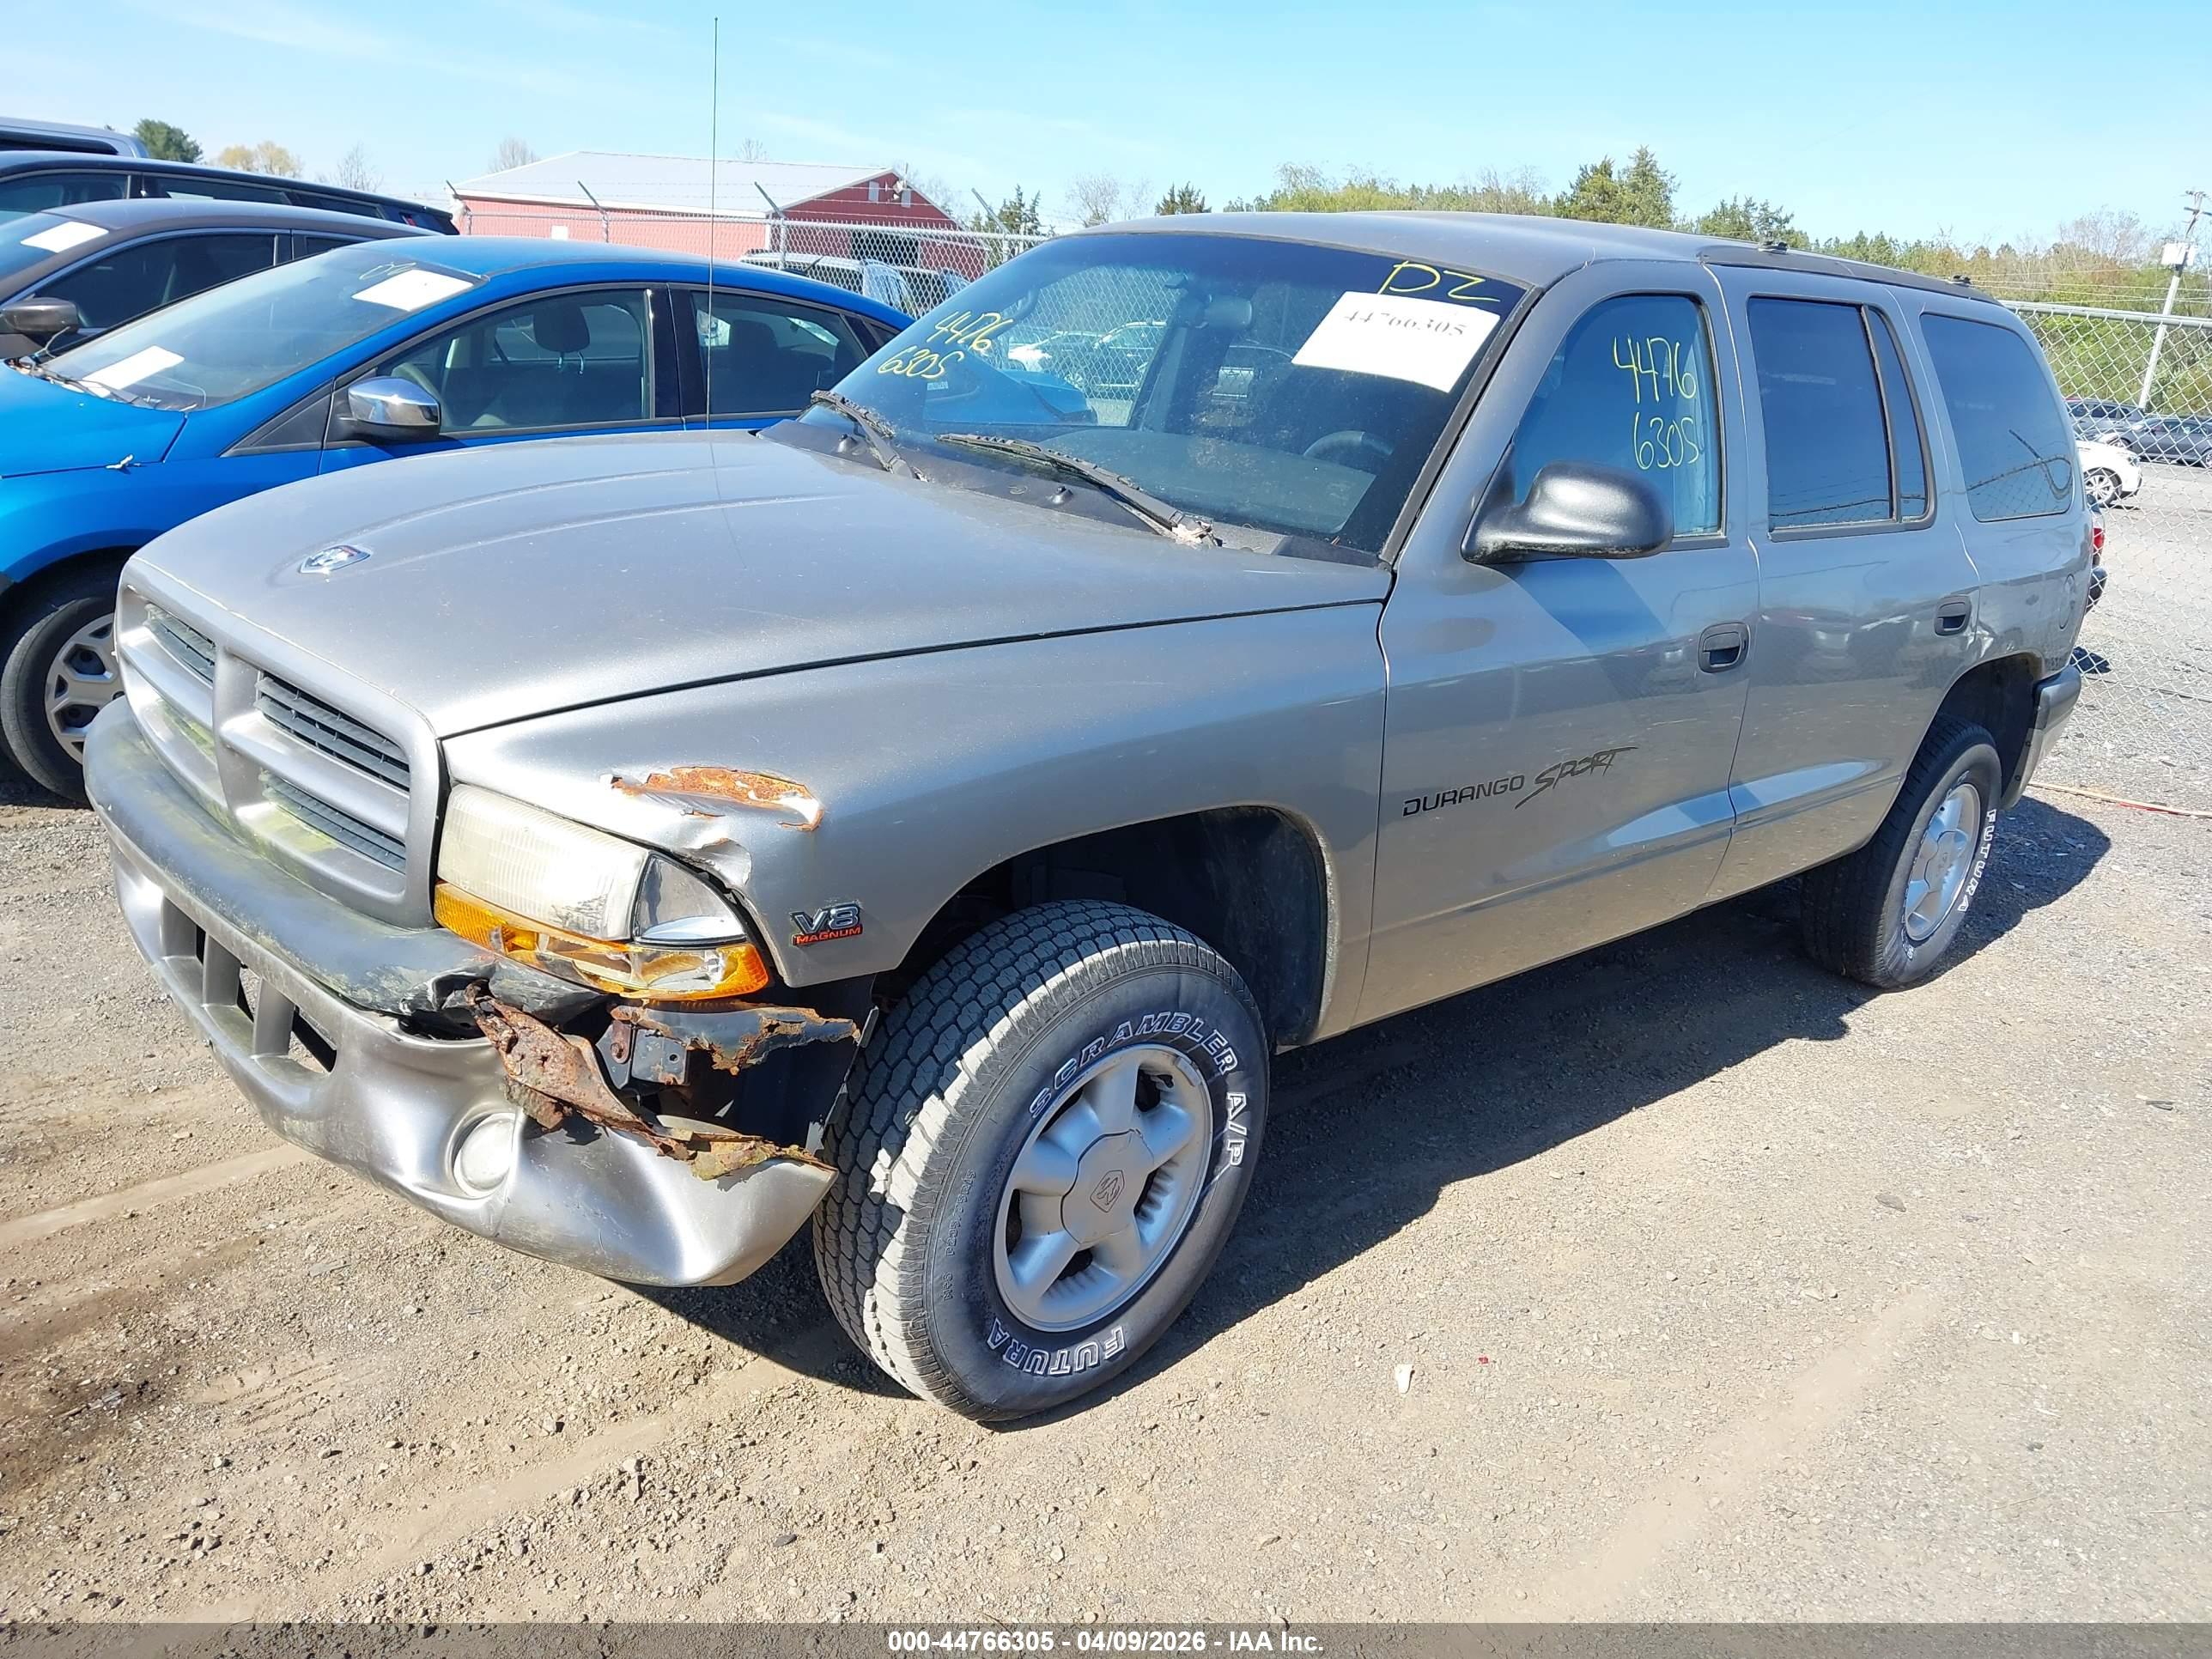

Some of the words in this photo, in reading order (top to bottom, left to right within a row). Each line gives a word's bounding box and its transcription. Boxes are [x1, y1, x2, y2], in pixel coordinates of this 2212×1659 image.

[926, 311, 1014, 351] 4476
[1613, 334, 1697, 404] 4476
[1633, 411, 1699, 470] 6305
[1402, 775, 1525, 817] DURANGO
[1514, 746, 1639, 810] SPORT
[1957, 808, 1997, 913] FUTURA
[791, 903, 860, 934] V8
[796, 927, 861, 945] MAGNUM
[1030, 1011, 1239, 1118] SCRAMBLER
[1225, 1091, 1248, 1167] A/P
[986, 1316, 1127, 1376] FUTURA
